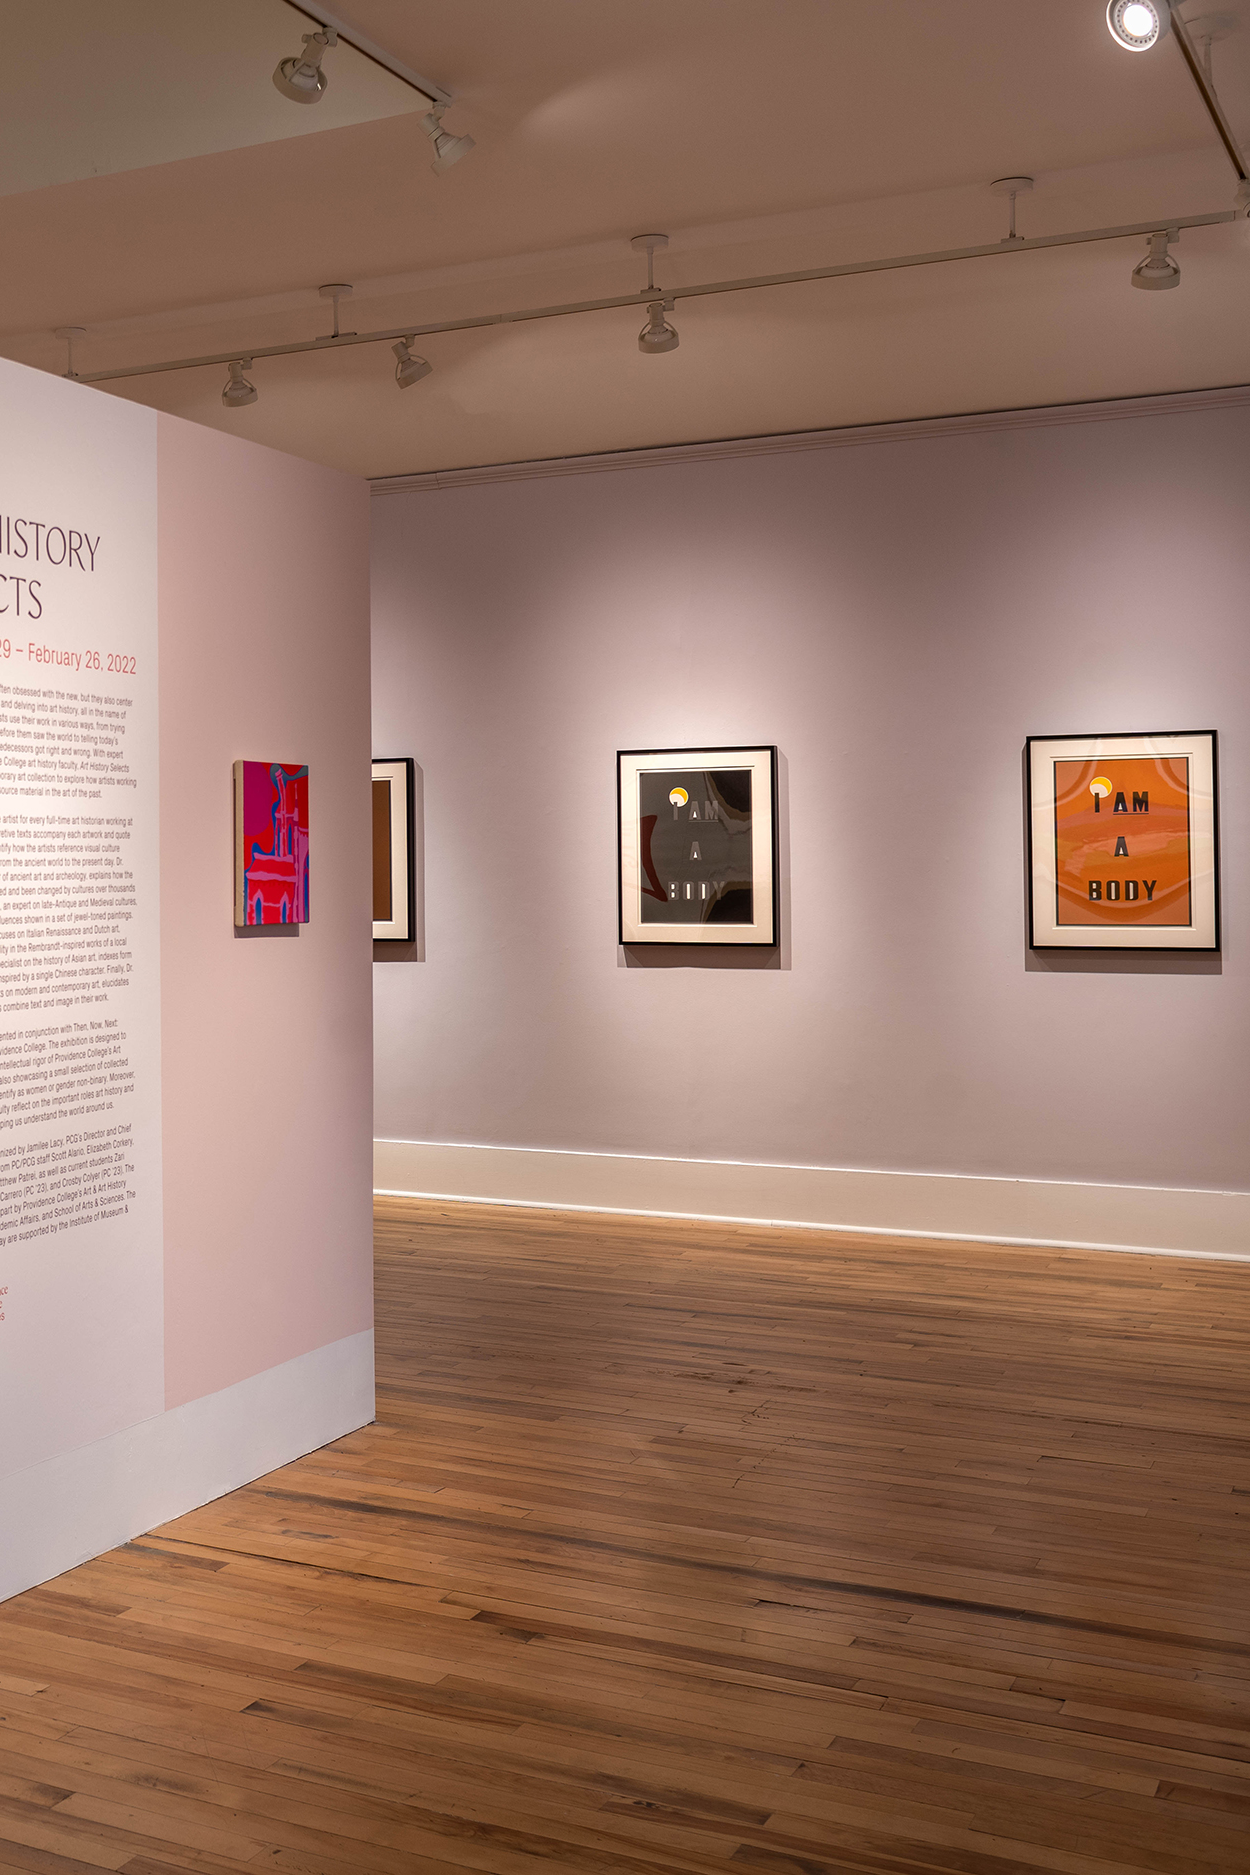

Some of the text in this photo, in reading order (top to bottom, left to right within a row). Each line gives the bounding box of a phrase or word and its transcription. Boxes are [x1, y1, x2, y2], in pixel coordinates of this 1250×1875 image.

[28, 643, 82, 671] February
[85, 651, 103, 671] 26,
[107, 654, 136, 675] 2022
[12, 685, 41, 697] obsessed
[42, 688, 54, 698] with
[55, 690, 65, 699] the
[80, 692, 90, 702] but
[90, 694, 103, 705] they
[103, 695, 115, 705] also
[115, 698, 132, 707] center
[34, 745, 45, 755] got
[45, 745, 60, 756] right
[60, 746, 72, 755] and
[92, 748, 105, 758] With
[106, 751, 123, 761] expert
[17, 772, 26, 781] art
[27, 772, 55, 782] collection
[63, 775, 84, 785] explore
[85, 775, 97, 784] how
[98, 776, 115, 785] artists
[116, 778, 137, 788] working
[689, 801, 719, 820] AM
[1094, 791, 1149, 813] I AM
[16, 830, 31, 838] texts
[32, 831, 66, 841] accompany
[67, 830, 81, 839] each
[82, 830, 103, 839] artwork
[103, 831, 114, 839] and
[115, 831, 130, 841] quote
[690, 841, 702, 860] A
[1114, 836, 1129, 857] A
[7, 886, 20, 896] and
[20, 886, 36, 895] been
[37, 885, 62, 897] changed
[71, 885, 94, 894] cultures
[107, 884, 135, 893] thousands
[668, 881, 725, 900] BODY
[1089, 880, 1157, 901] BODY
[16, 944, 27, 953] the
[27, 940, 85, 952] Rembrandt-inspired
[85, 939, 102, 949] works
[113, 937, 127, 947] local
[14, 986, 38, 996] modern
[38, 984, 50, 994] and
[51, 983, 90, 993] contemporary
[101, 978, 129, 988] elucidates
[2, 1001, 29, 1012] combine
[30, 1000, 42, 1009] text
[43, 998, 54, 1008] and
[55, 998, 73, 1008] image
[80, 994, 93, 1004] their
[12, 1070, 48, 1083] showcasing
[53, 1066, 69, 1077] small
[70, 1063, 96, 1074] selection
[103, 1057, 128, 1069] collected
[10, 1101, 30, 1112] reflect
[40, 1097, 50, 1107] the
[51, 1093, 79, 1106] important
[80, 1091, 94, 1100] roles
[95, 1089, 103, 1098] art
[104, 1087, 122, 1096] history
[123, 1083, 134, 1093] and
[41, 1209, 53, 1220] and
[54, 1204, 74, 1217] School
[81, 1200, 93, 1210] Arts
[126, 1189, 135, 1199] The
